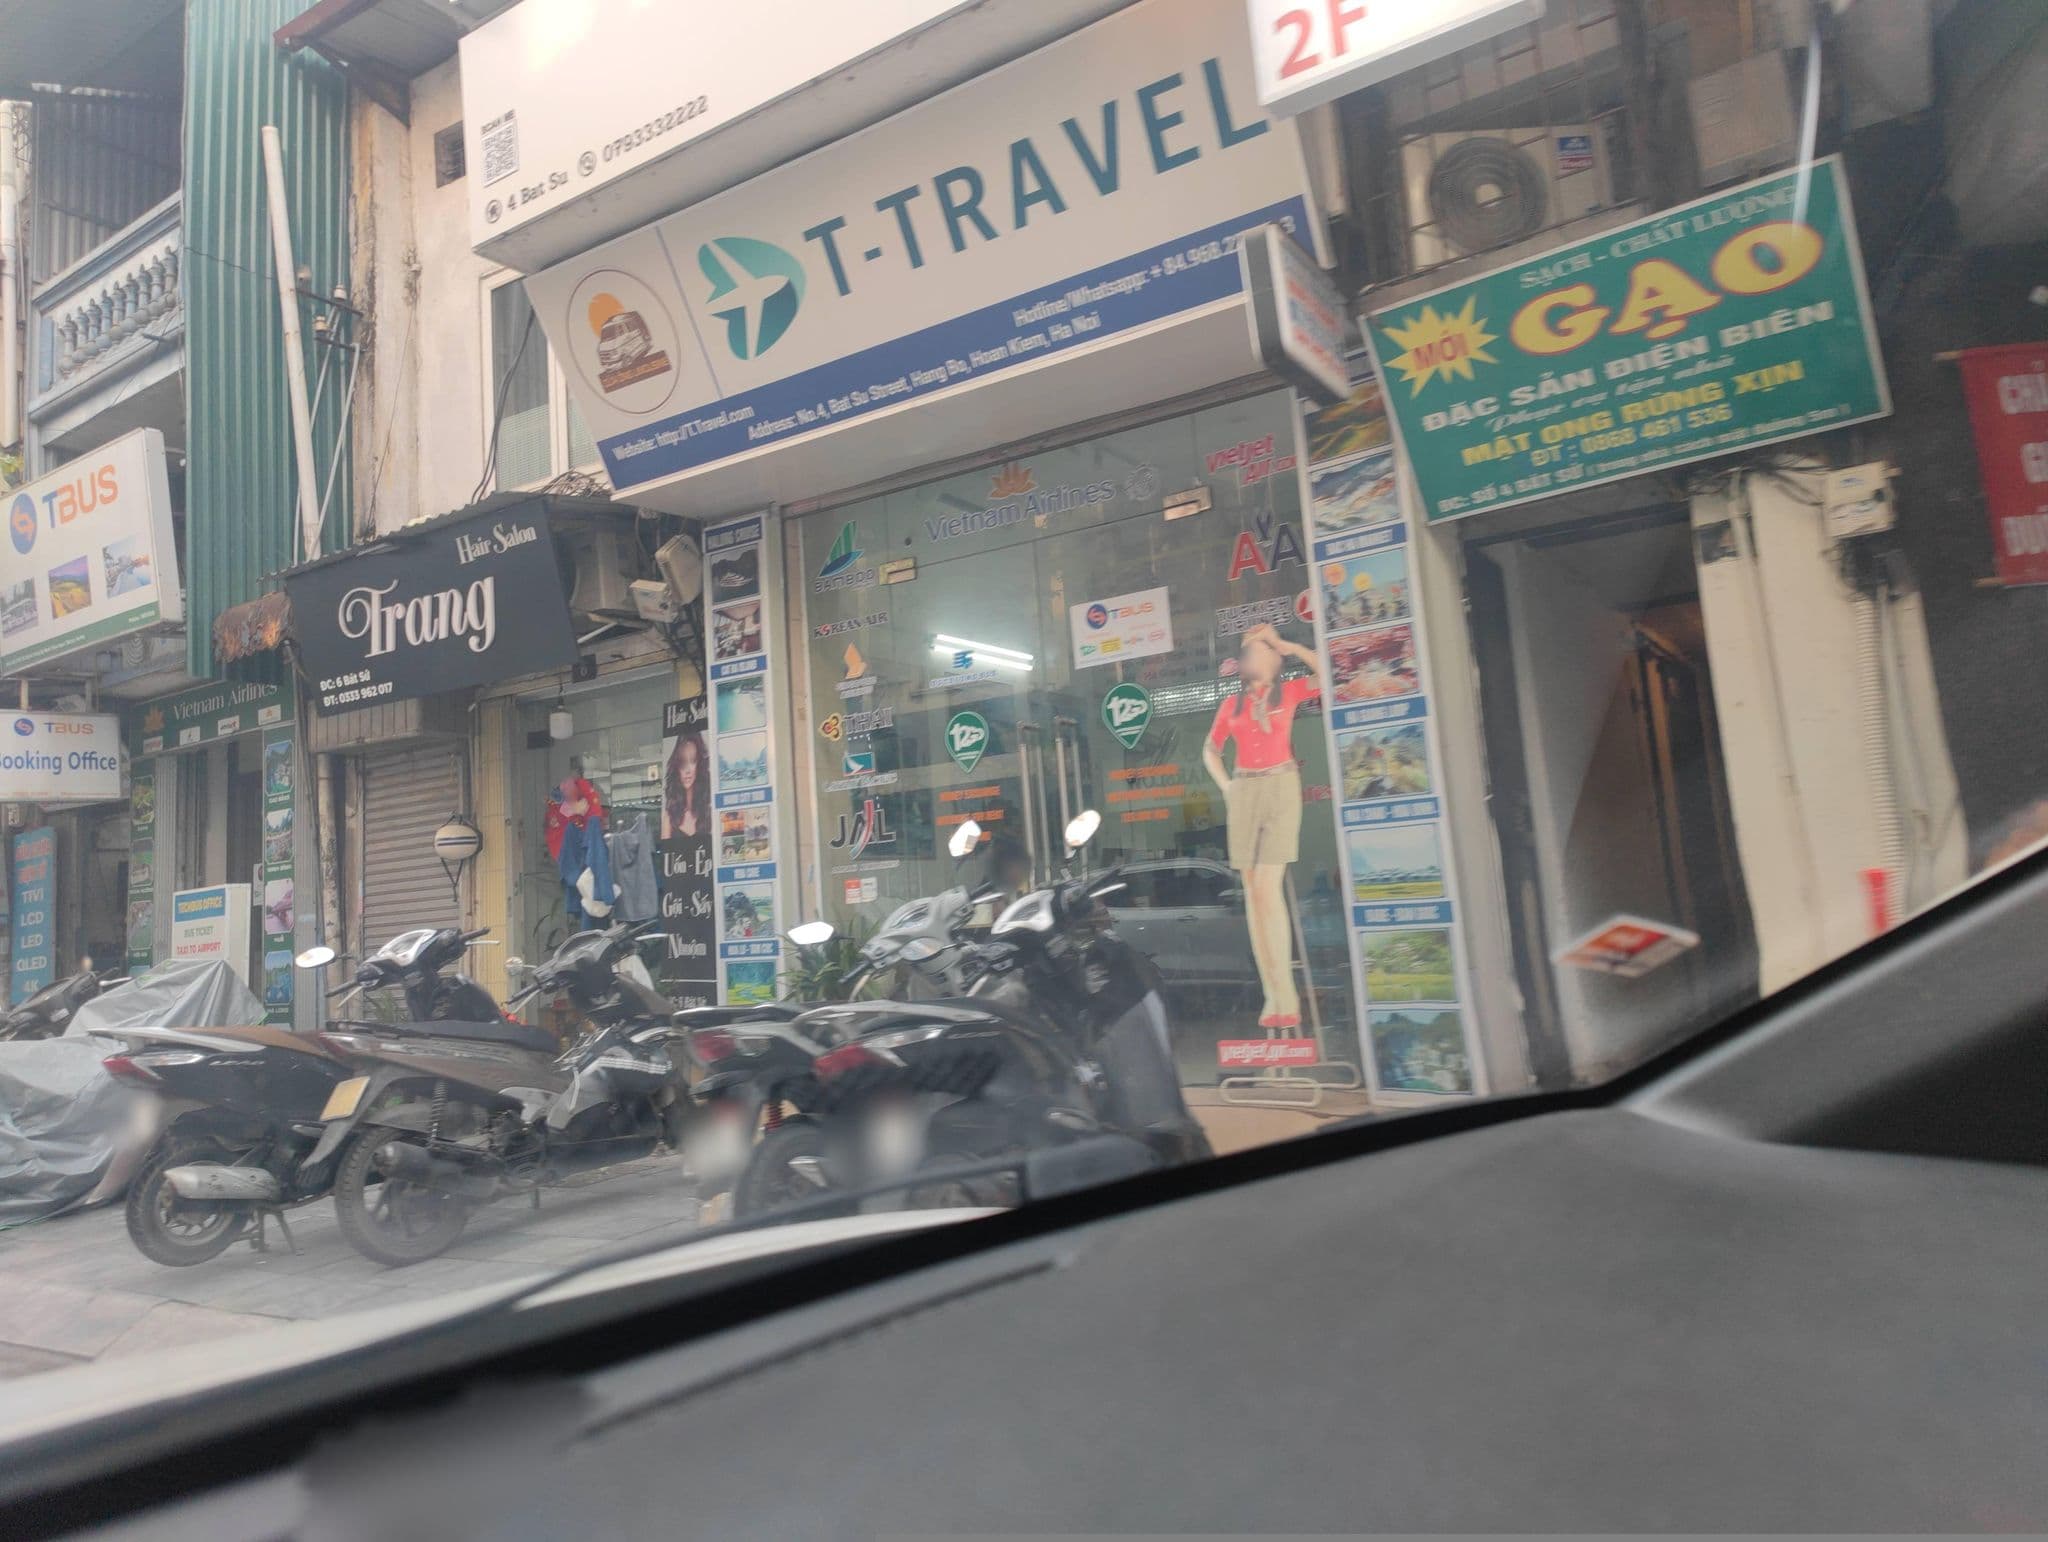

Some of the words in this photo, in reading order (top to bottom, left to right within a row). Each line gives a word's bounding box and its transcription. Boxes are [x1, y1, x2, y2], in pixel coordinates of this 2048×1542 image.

[801, 56, 1271, 297] T-TRAVEL
[507, 195, 516, 210] 4
[1509, 219, 1824, 357] GẠO
[1412, 329, 1469, 371] MỚI
[1422, 397, 1500, 432] ĐẶC
[1509, 371, 1597, 407] SẢN
[1604, 334, 1711, 380] ĐIỆN
[1719, 300, 1835, 348] BIÊN
[42, 464, 119, 529] TBUS
[923, 501, 1021, 545] Vietnam
[1020, 477, 1118, 524] Airlines
[455, 533, 491, 565] Hair
[493, 522, 537, 554] Salon
[338, 576, 496, 658] Trang
[336, 676, 343, 688] 6
[173, 692, 225, 722] Vietnam
[44, 721, 95, 736] TBUS
[68, 751, 118, 771] Office
[20, 911, 45, 927] LCD
[20, 933, 43, 949] LED
